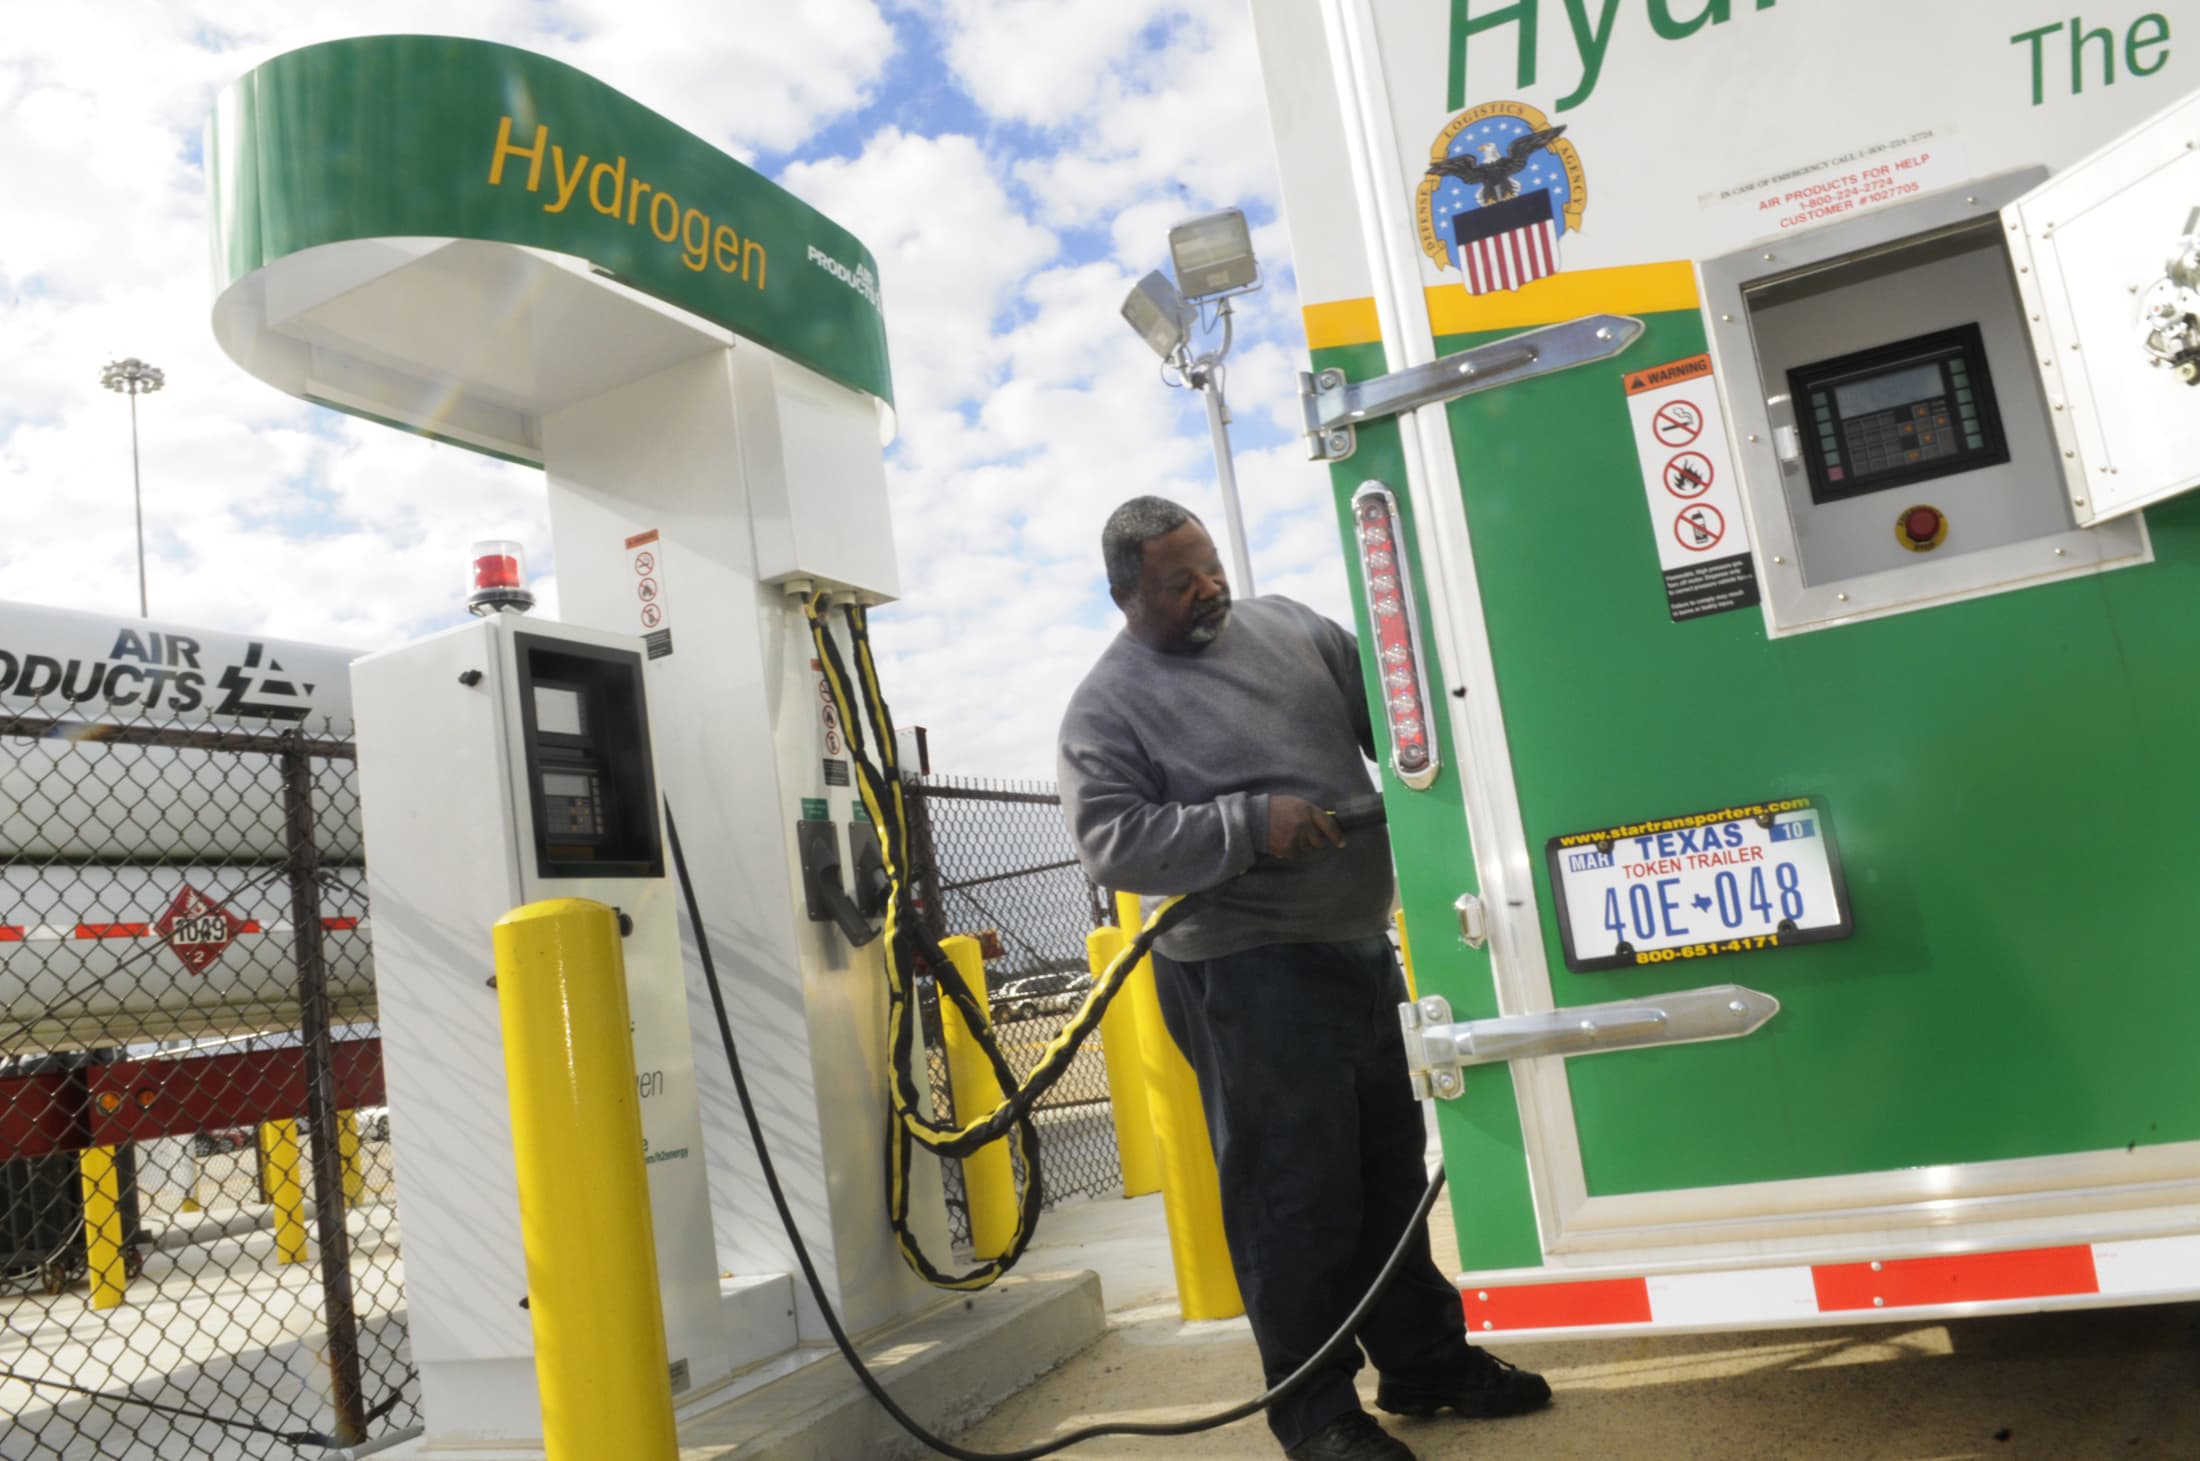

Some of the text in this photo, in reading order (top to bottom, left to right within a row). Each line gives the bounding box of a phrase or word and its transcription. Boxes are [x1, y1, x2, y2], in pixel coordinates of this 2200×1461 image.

[1447, 0, 1776, 113] Hy
[2010, 12, 2170, 106] The
[1444, 104, 1525, 138] LOGISTICS
[1562, 147, 1584, 207] AGENCY
[1758, 153, 1930, 211] AIR PRODUCTS FOR HELP
[1772, 161, 1829, 184] EMERGENCY
[488, 116, 767, 289] Hydrogen
[1799, 177, 1894, 211] 1-800-224-2724
[1419, 189, 1435, 250] DEFENSE
[1780, 199, 1854, 229] CUSTOMER
[1647, 358, 1708, 385] WARNING
[109, 628, 201, 669] AIR
[1560, 797, 1811, 848] www.startransporters.com
[1781, 822, 1804, 840] 10
[1635, 823, 1744, 860] TEXAS
[1570, 853, 1610, 873] MAR
[1622, 846, 1764, 880] TOKEN TRAILER
[192, 951, 205, 964] 2
[1635, 934, 1780, 966] 800-651-4171
